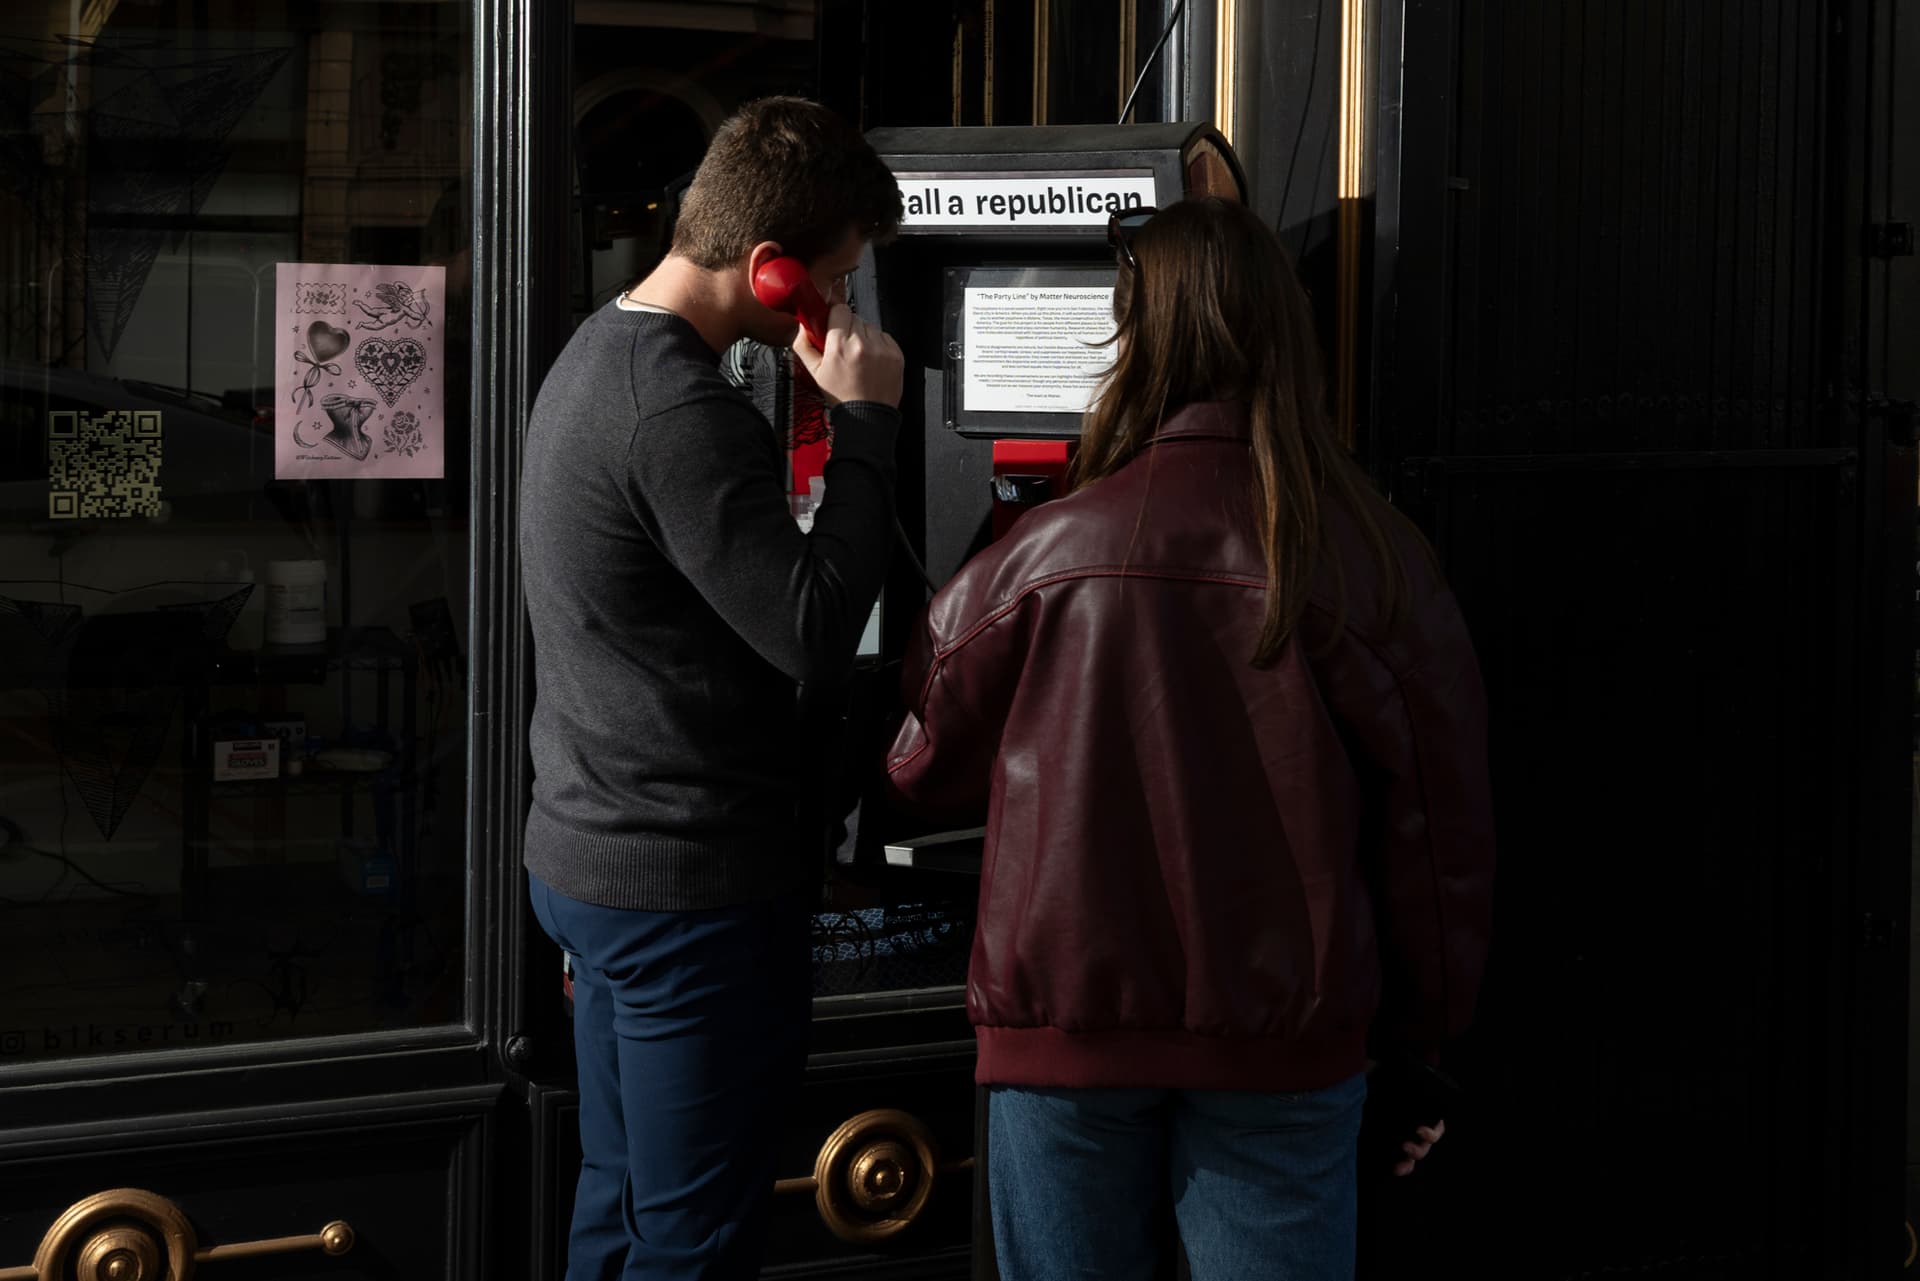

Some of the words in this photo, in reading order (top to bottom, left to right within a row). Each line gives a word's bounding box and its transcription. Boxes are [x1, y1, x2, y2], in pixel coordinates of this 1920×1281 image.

[899, 187, 941, 215] all
[948, 194, 964, 215] a
[976, 186, 1142, 221] republican
[994, 293, 1011, 301] Party
[1030, 293, 1039, 301] by
